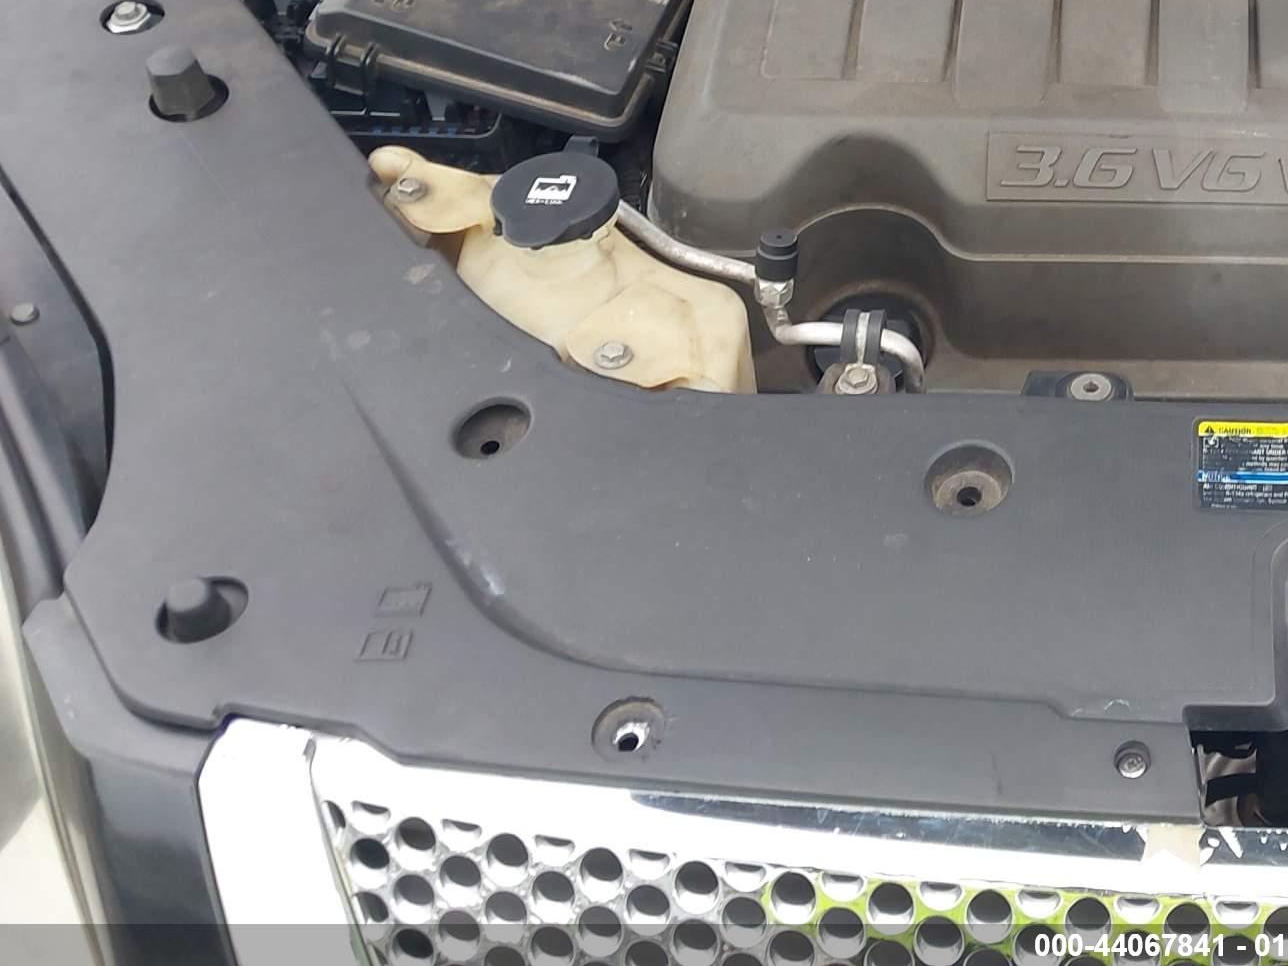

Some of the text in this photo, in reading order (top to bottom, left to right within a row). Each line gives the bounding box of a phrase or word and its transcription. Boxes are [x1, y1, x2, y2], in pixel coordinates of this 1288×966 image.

[1000, 145, 1137, 188] 3.6
[1153, 147, 1267, 193] V6
[1218, 427, 1252, 436] CAUTION
